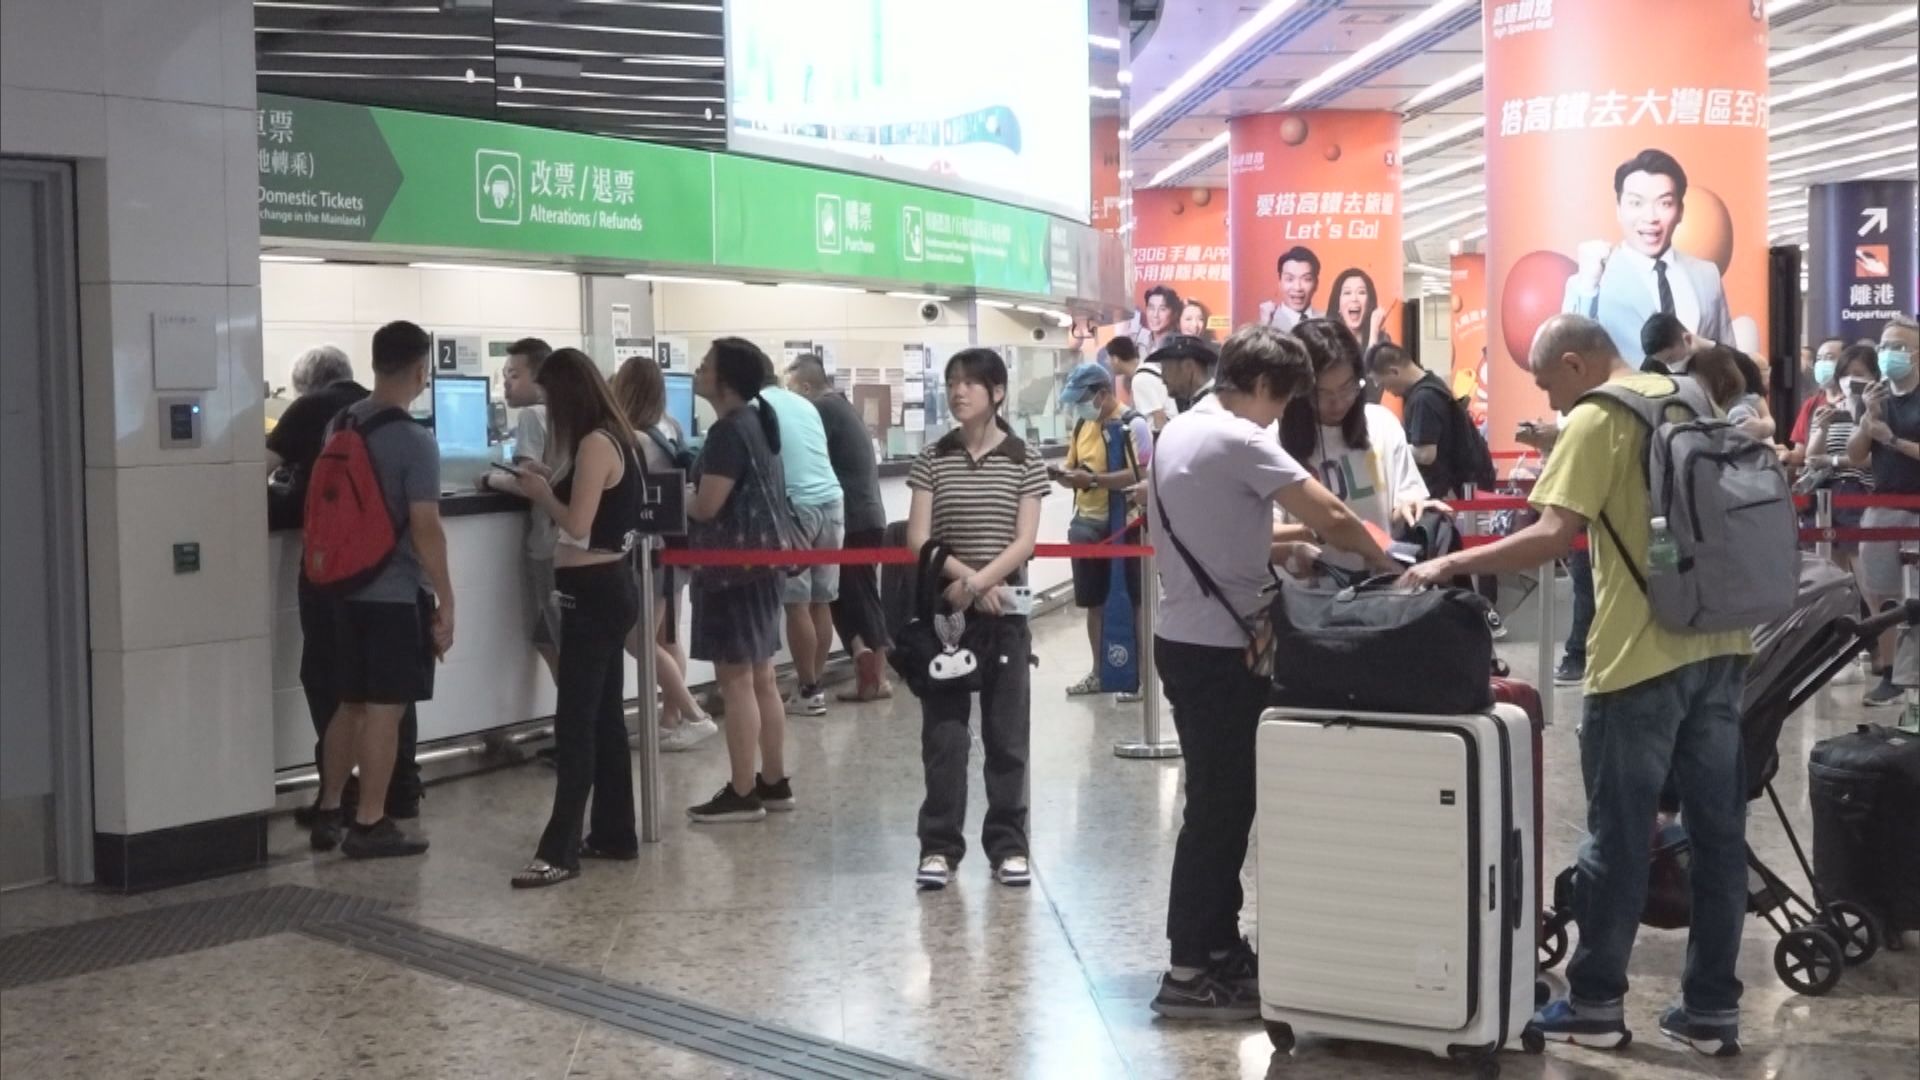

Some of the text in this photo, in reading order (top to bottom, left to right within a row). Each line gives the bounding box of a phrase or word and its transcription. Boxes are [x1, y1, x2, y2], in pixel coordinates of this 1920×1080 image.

[258, 186, 363, 211] Domestic Tickets
[295, 212, 304, 222] in
[305, 210, 320, 223] the
[529, 203, 591, 227] Alterations
[599, 210, 643, 231] Refunds
[1285, 217, 1343, 240] Let's
[1841, 309, 1902, 321] Departures
[442, 345, 452, 364] 2
[660, 347, 668, 364] 3
